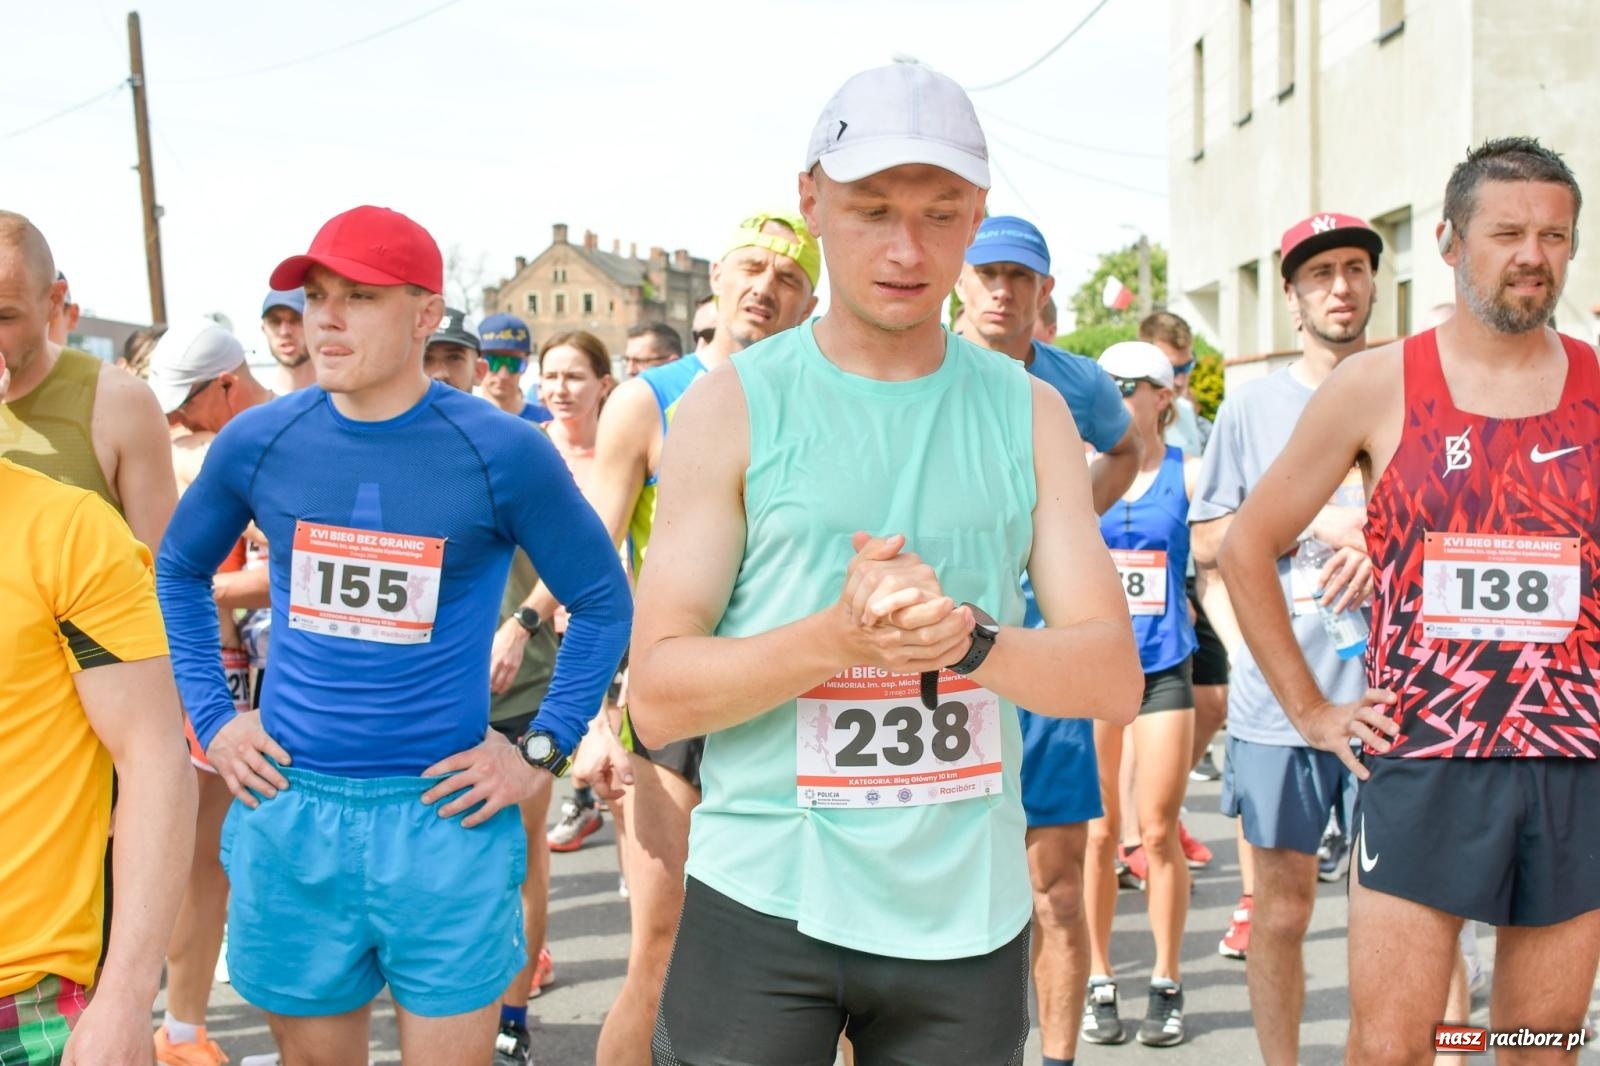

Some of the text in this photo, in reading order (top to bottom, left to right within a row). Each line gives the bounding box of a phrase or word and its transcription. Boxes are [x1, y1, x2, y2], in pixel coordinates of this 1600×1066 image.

[309, 528, 329, 540] XVI
[330, 532, 355, 544] BIEG
[356, 535, 378, 547] BEZ
[379, 538, 425, 551] GRANIC
[1443, 537, 1562, 551] XVI BIEG BEZ GRANIC
[317, 560, 408, 613] 155
[1118, 572, 1145, 597] 8
[1456, 567, 1549, 613] 138
[852, 666, 888, 679] BIEG
[827, 681, 866, 689] MEMORIAŁ
[881, 681, 897, 689] asp.
[834, 700, 971, 767] 238
[848, 771, 957, 786] KATEGORIA: Bieg Główny 10 km
[817, 791, 840, 799] POLICJA
[939, 782, 976, 795] Racibórz
